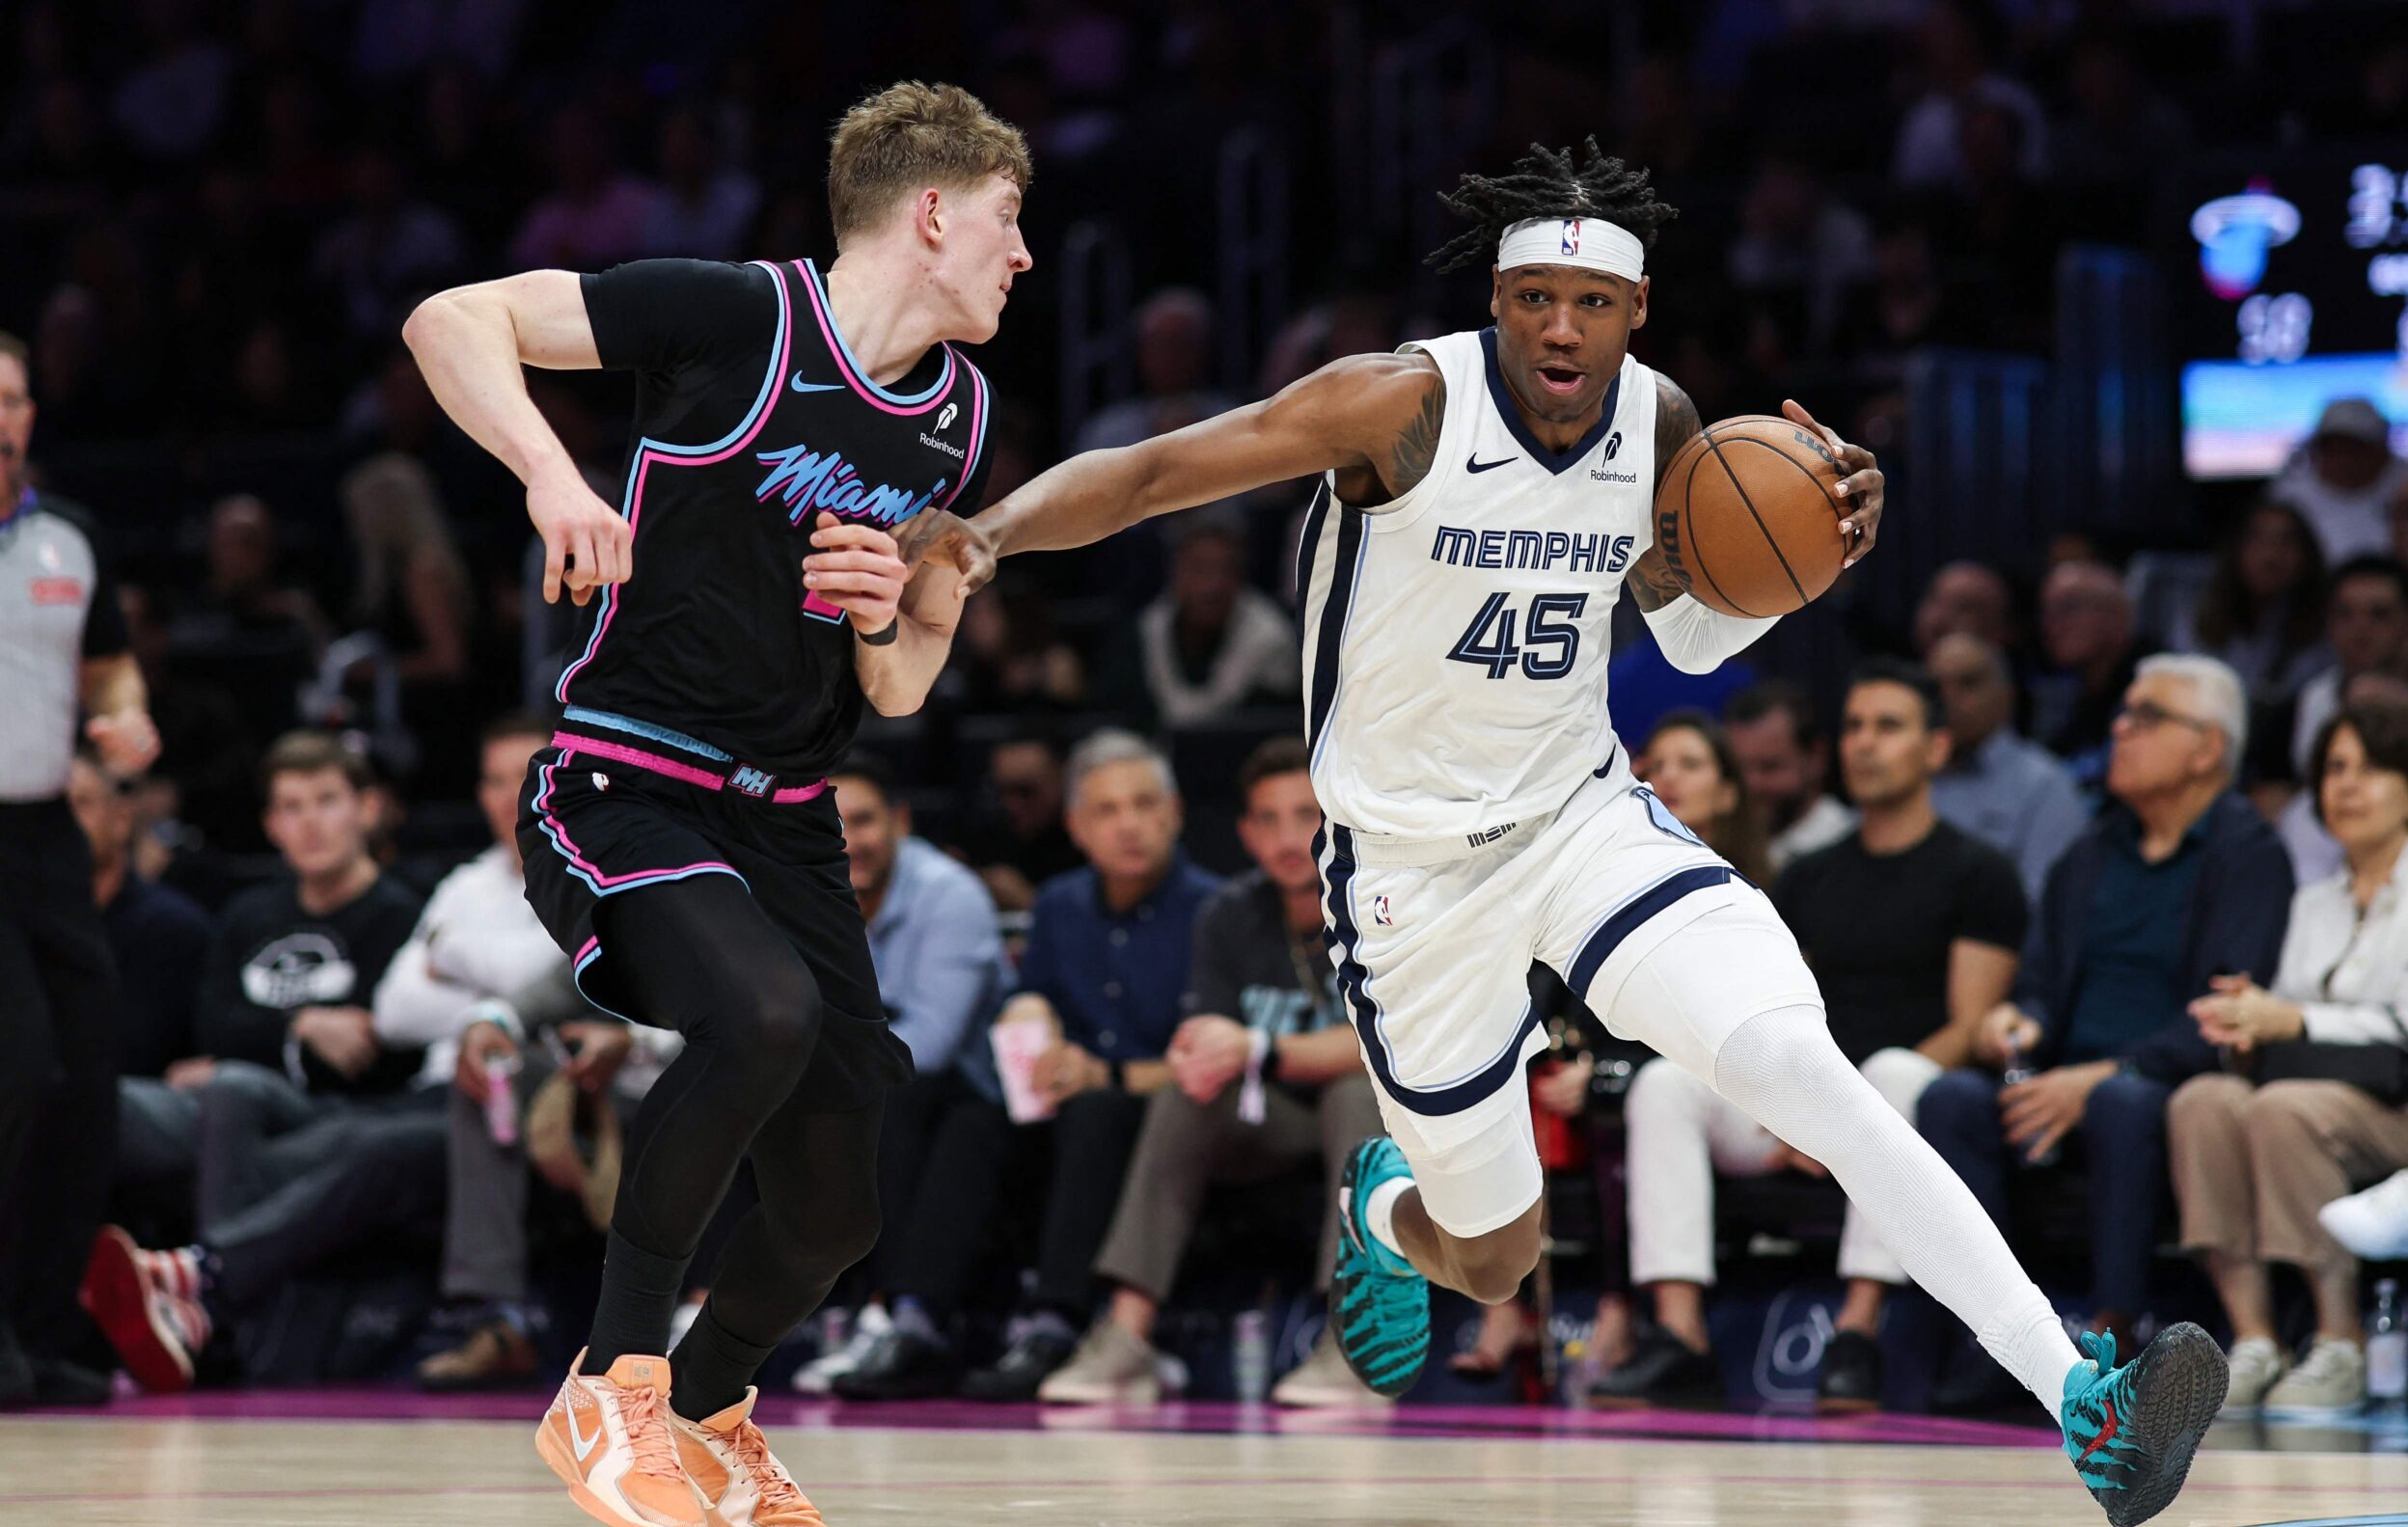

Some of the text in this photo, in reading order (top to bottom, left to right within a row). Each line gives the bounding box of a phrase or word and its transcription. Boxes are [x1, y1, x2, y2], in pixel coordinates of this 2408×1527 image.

[919, 431, 965, 460] Robinhood
[755, 444, 947, 528] Miami
[1590, 469, 1636, 483] Robinhood
[1431, 525, 1634, 573] MEMPHIS
[1445, 591, 1590, 680] 45
